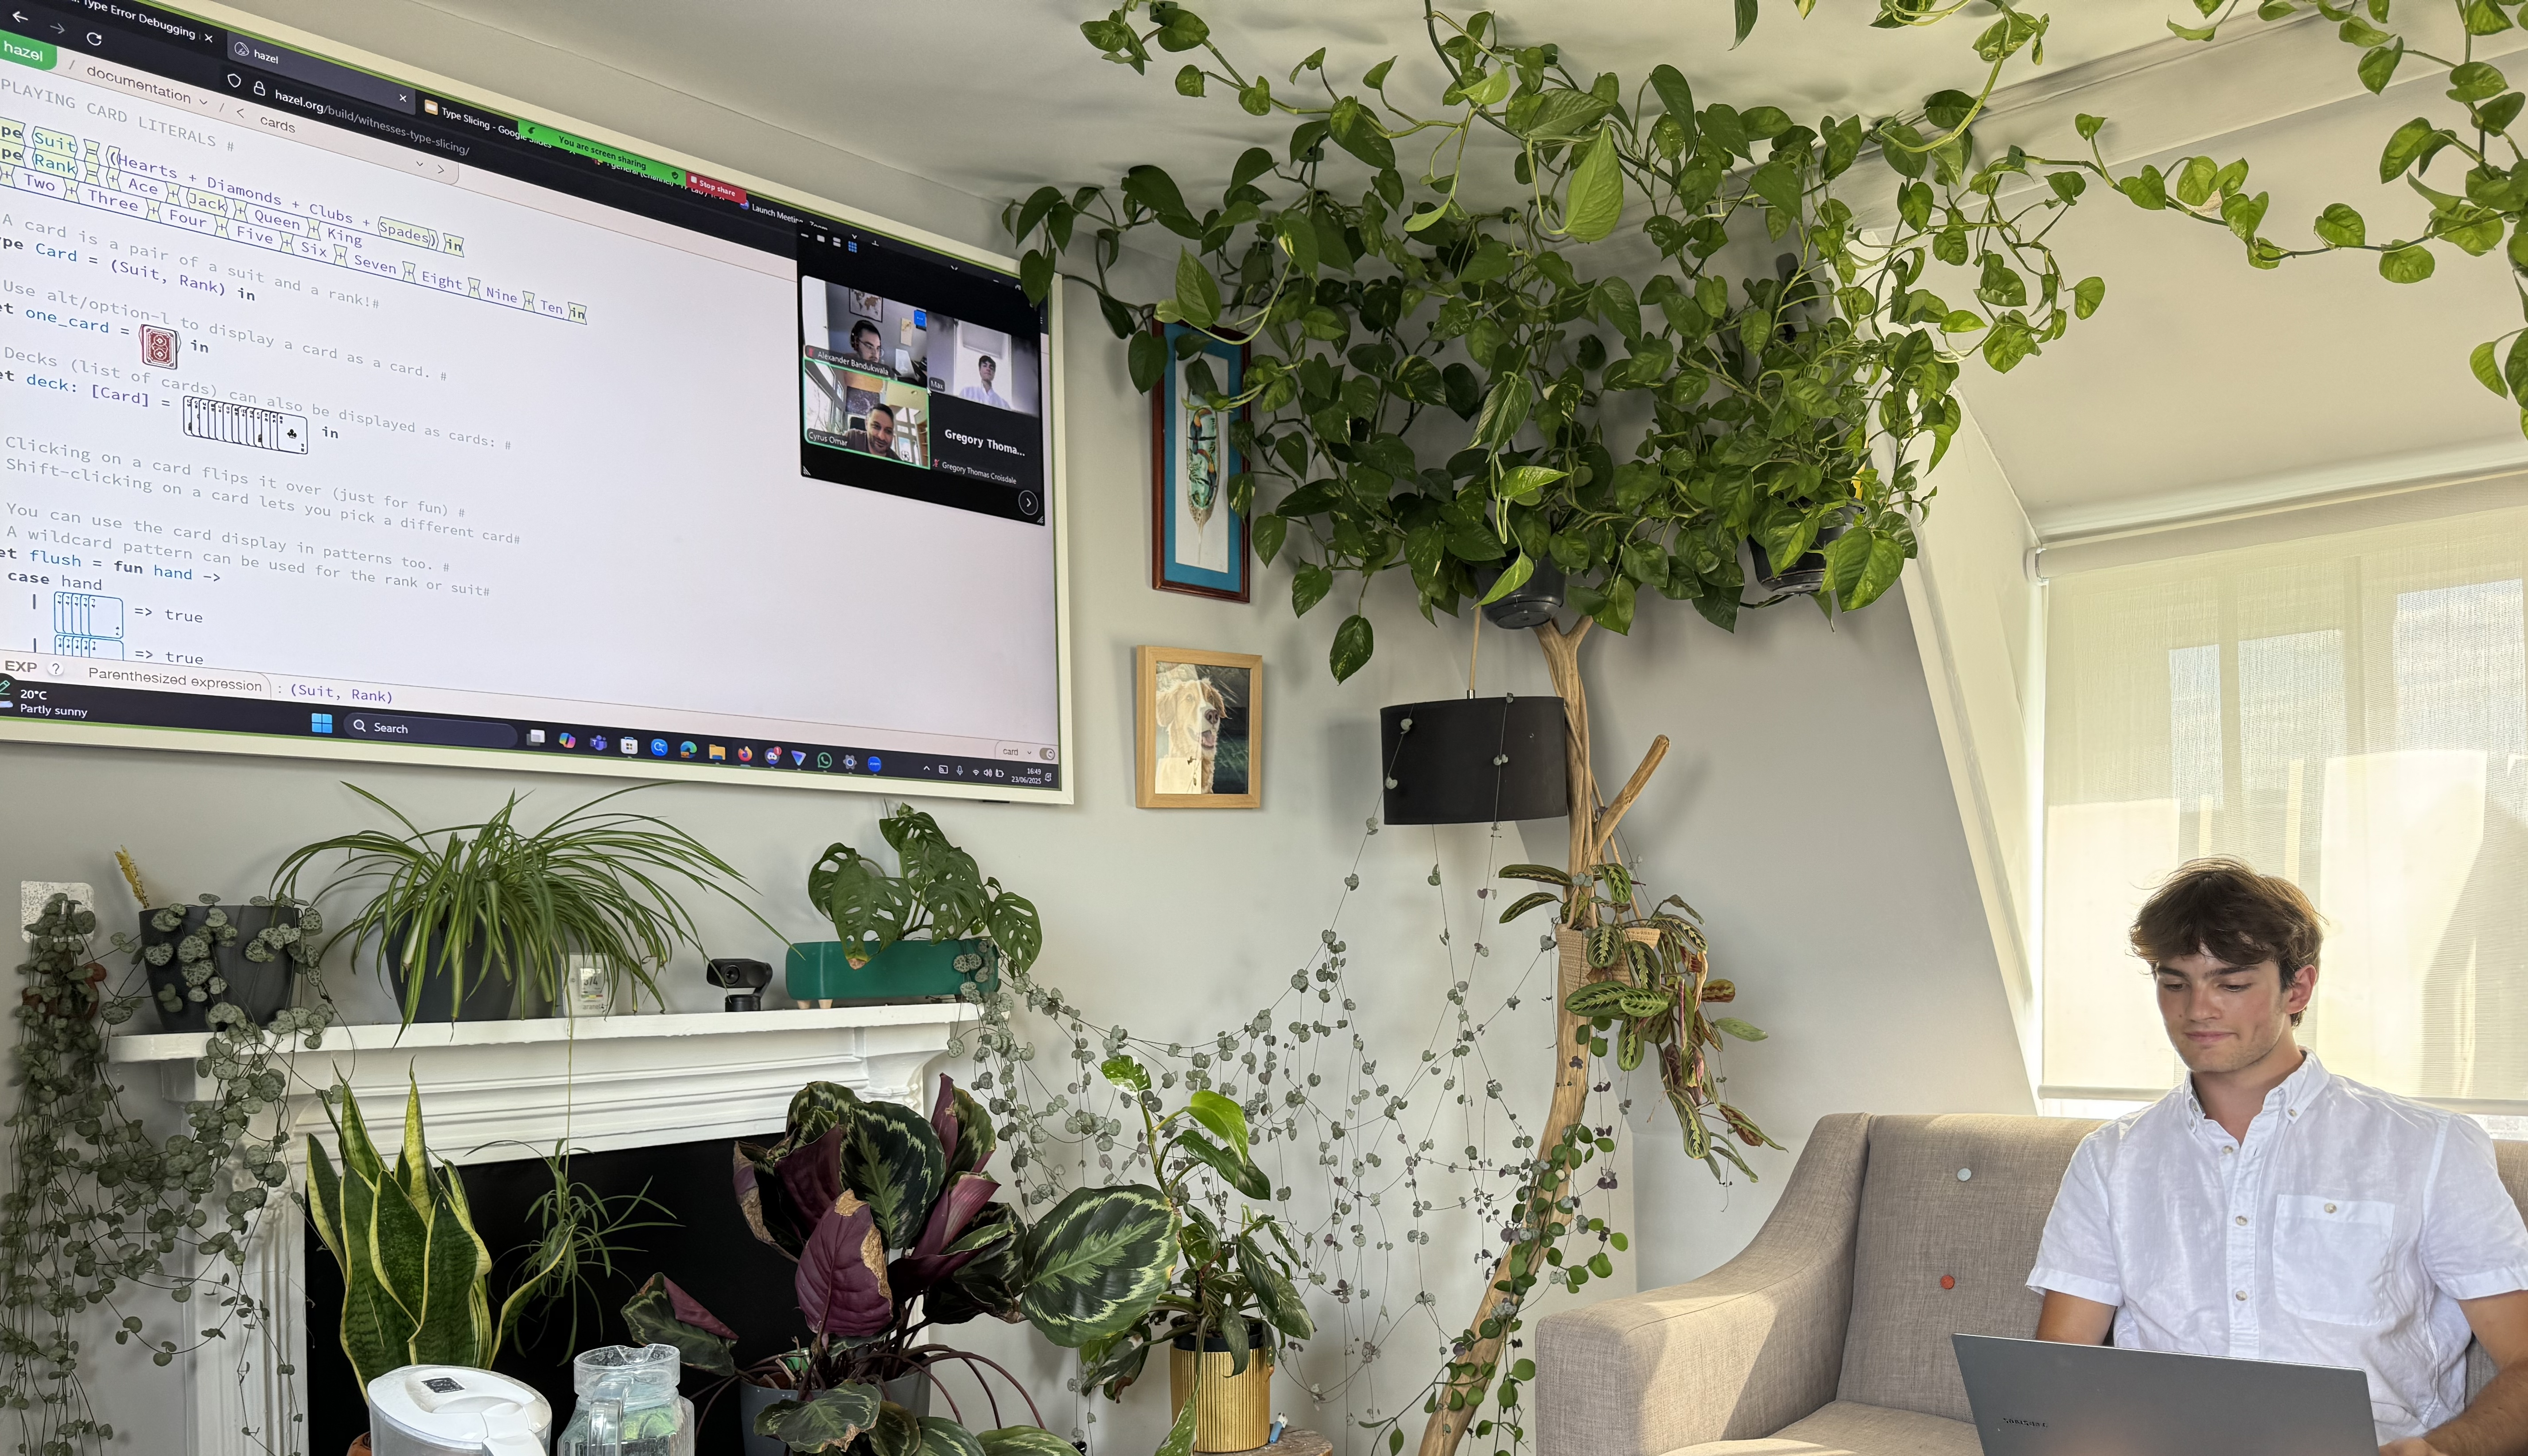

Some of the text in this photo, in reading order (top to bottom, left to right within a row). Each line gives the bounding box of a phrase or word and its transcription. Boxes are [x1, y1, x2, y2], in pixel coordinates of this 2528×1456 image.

[111, 5, 136, 20] Error
[139, 14, 195, 40] Debugging
[4, 41, 43, 62] hazel
[254, 49, 278, 64] hazel
[87, 66, 296, 133] documentation cards
[1, 79, 216, 147] PLAYING CARD LITERALS
[275, 89, 470, 156] hazel.org/build/witnesses-type-slicing/
[442, 107, 461, 120] Type
[464, 114, 490, 131] Slicing
[559, 136, 574, 147] You
[576, 143, 589, 151] are
[591, 147, 616, 160] screen
[618, 155, 646, 171] sharing
[35, 132, 76, 153] Suit
[110, 151, 177, 179] (Hearts
[208, 177, 281, 206] Diamonds
[310, 204, 353, 224] Clubs
[380, 222, 436, 247] Spades)
[447, 239, 461, 252] in
[700, 180, 715, 191] Stop
[717, 186, 735, 196] share
[35, 154, 78, 174] Rank
[128, 178, 158, 194] Ace
[189, 193, 226, 212] Jack
[255, 210, 300, 230] Queen
[328, 228, 362, 248] King
[752, 204, 775, 217] Launch
[2, 214, 13, 226] A
[26, 221, 66, 238] card
[79, 230, 97, 245] is
[130, 245, 169, 260] pair
[179, 256, 198, 268] of
[228, 267, 264, 283] suit
[275, 278, 300, 291] and
[24, 173, 584, 319] Two Three Four Five Six Seven Eight Nine Ten in
[0, 237, 255, 301] pe Card (Suit, Rank) in
[3, 279, 429, 378] Use alt/option-l to display card as card.
[26, 309, 209, 353] one_card in
[818, 351, 889, 375] Alexander Bandukwala
[5, 347, 494, 447] Decks (list of cards) can also be displayed as cards:
[931, 380, 944, 390] Max
[27, 374, 338, 439] deck: [Card] in
[809, 431, 848, 447] Cyrus Omar
[945, 429, 1025, 456] Gregory Thoma...
[6, 436, 447, 516] Clicking on card flips it over (just for fun)
[942, 462, 966, 474] Gregory
[967, 467, 990, 478] Thomas
[6, 458, 520, 544] Shift-clicking on card lets you pick different card#
[7, 502, 432, 570] You can use the card display in patterns too.
[7, 526, 17, 538] A
[28, 529, 112, 549] wildcard
[124, 542, 192, 559] pattern
[203, 553, 231, 564] can
[241, 555, 259, 568] be
[269, 561, 304, 574] used
[316, 565, 340, 578] for
[351, 570, 375, 582] the
[386, 576, 417, 587] rank
[30, 550, 81, 567] flush
[114, 560, 143, 574] fun
[155, 564, 192, 580] hand
[8, 572, 102, 590] case hand
[165, 610, 203, 623] true
[5, 660, 37, 672] EXP
[166, 652, 203, 664] true
[89, 667, 261, 691] Parenthesized expression
[20, 690, 47, 700] 20°C
[291, 683, 392, 704] (Suit, Rank)
[21, 703, 88, 718] Partly sunny
[374, 722, 408, 734] Search
[1003, 747, 1019, 756] card
[1011, 776, 1042, 784] 23/06/2025
